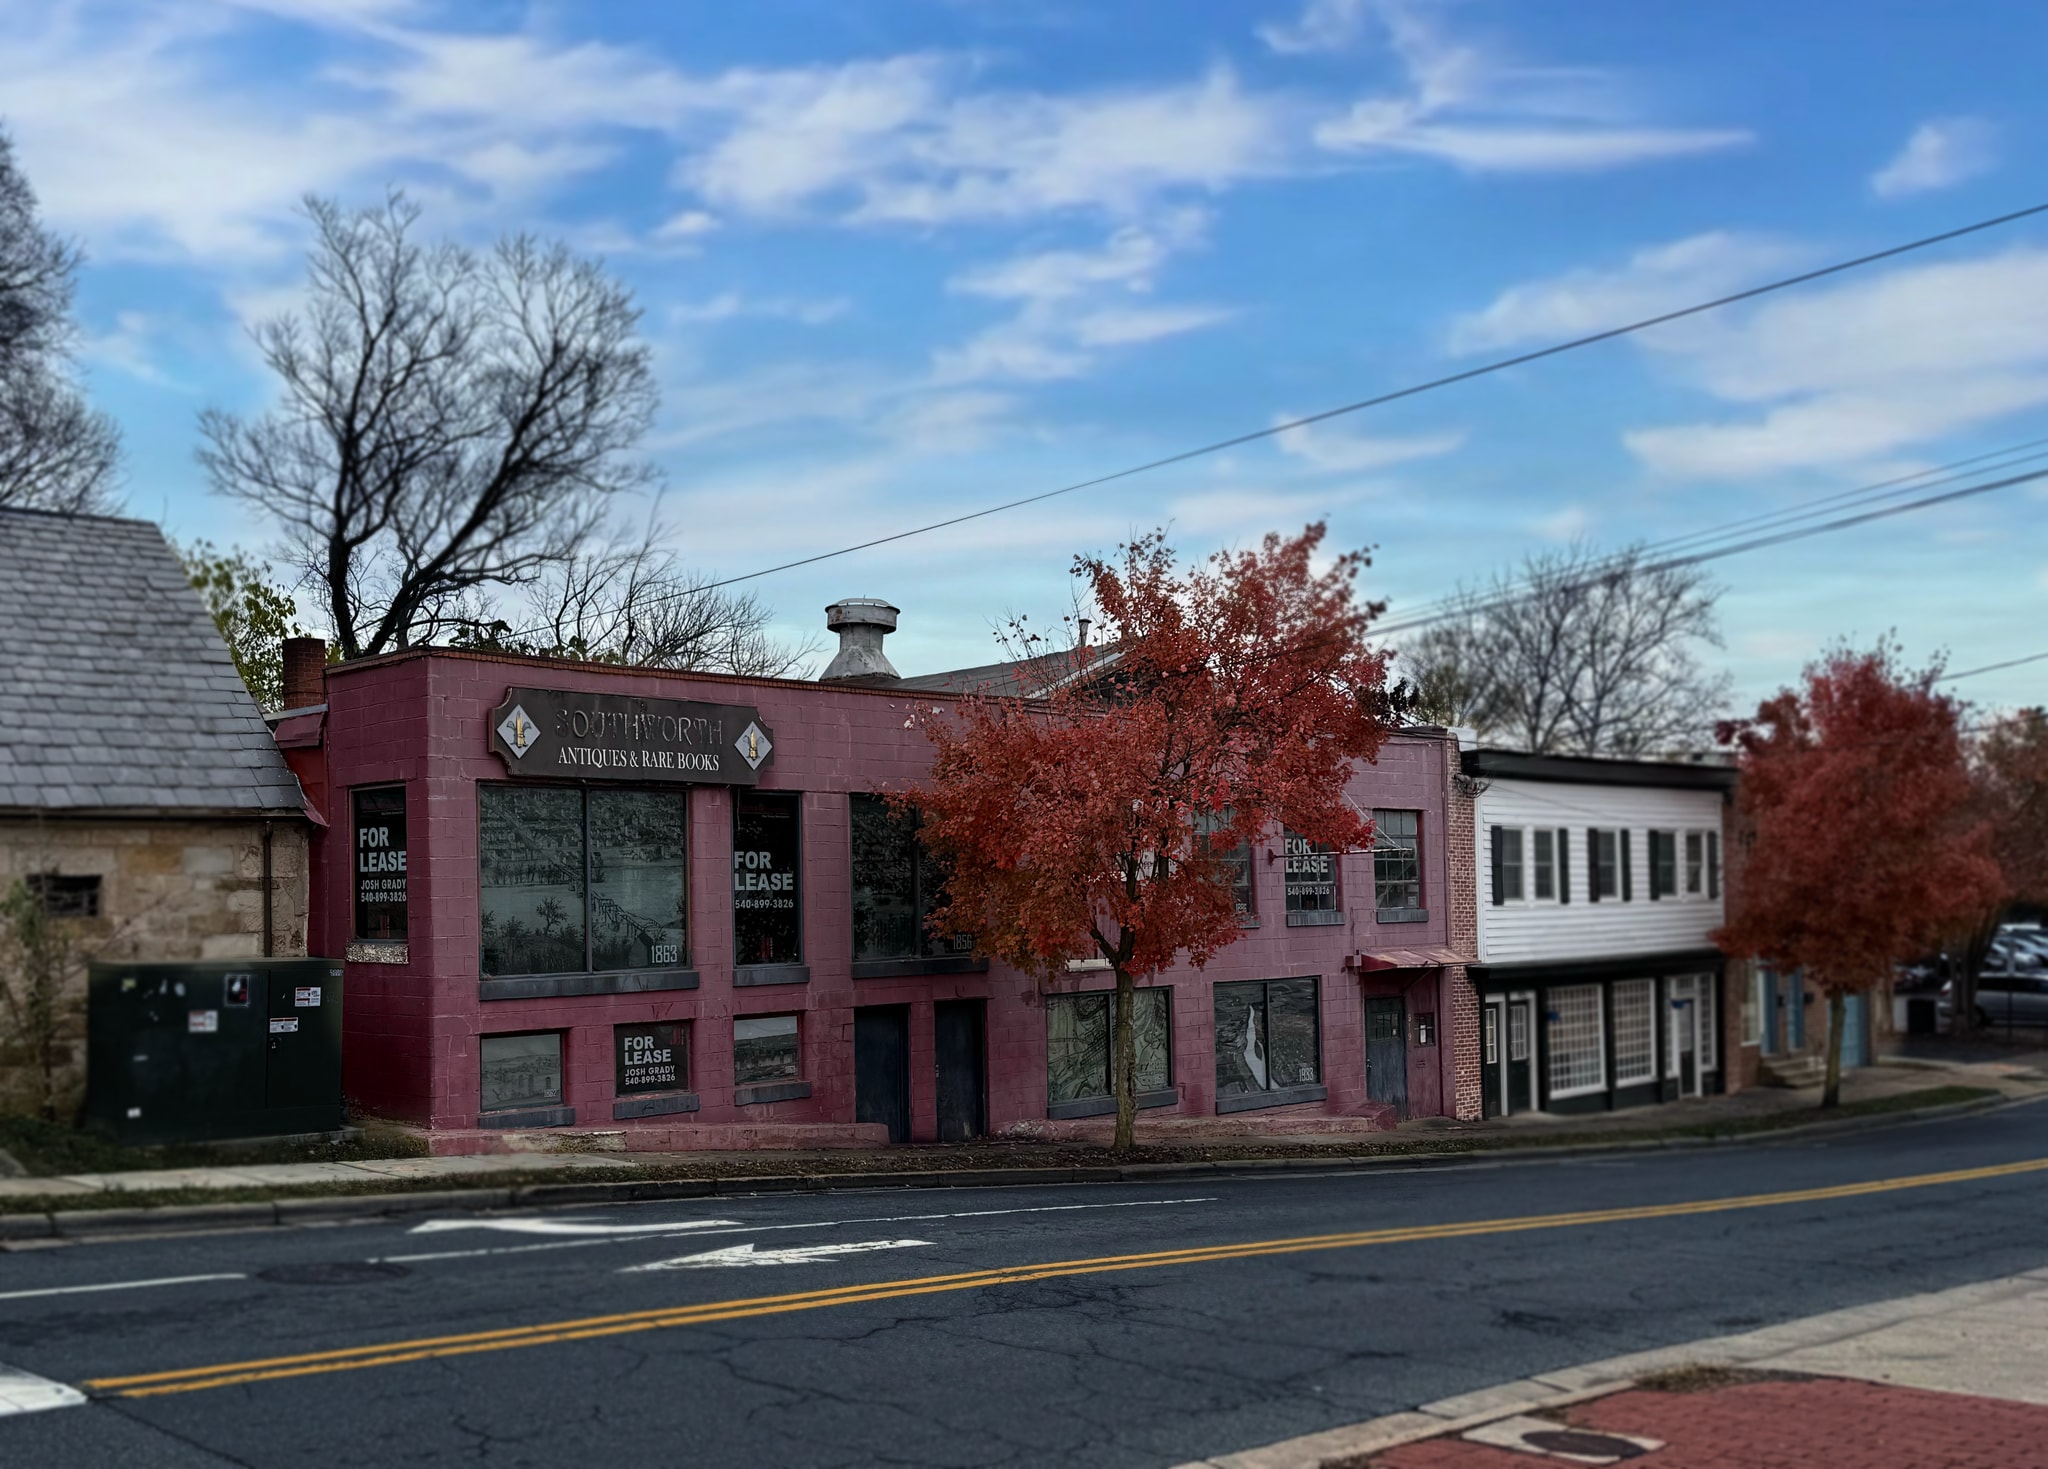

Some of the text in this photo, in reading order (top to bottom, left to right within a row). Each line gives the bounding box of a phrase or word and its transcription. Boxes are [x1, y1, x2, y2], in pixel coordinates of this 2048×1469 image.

[555, 708, 724, 745] SOUTHWORTH
[558, 746, 720, 771] ANTIQUES & RARE BOOKS
[359, 826, 389, 848] FOR
[1285, 838, 1311, 854] FOR
[359, 850, 407, 872] LEASE
[734, 851, 772, 869] FOR
[1285, 855, 1328, 873] LEASE
[360, 878, 407, 890] JOSH GRADY
[734, 873, 793, 891] LEASE
[360, 891, 407, 902] 540-899-3826
[735, 899, 794, 909] 540-899-3826
[953, 934, 972, 950] 1856
[651, 945, 677, 964] 1863
[624, 1035, 655, 1051] FOR
[624, 1049, 672, 1066] LEASE
[625, 1065, 676, 1077] JOSH GRADY
[625, 1074, 676, 1085] 540-899-3826
